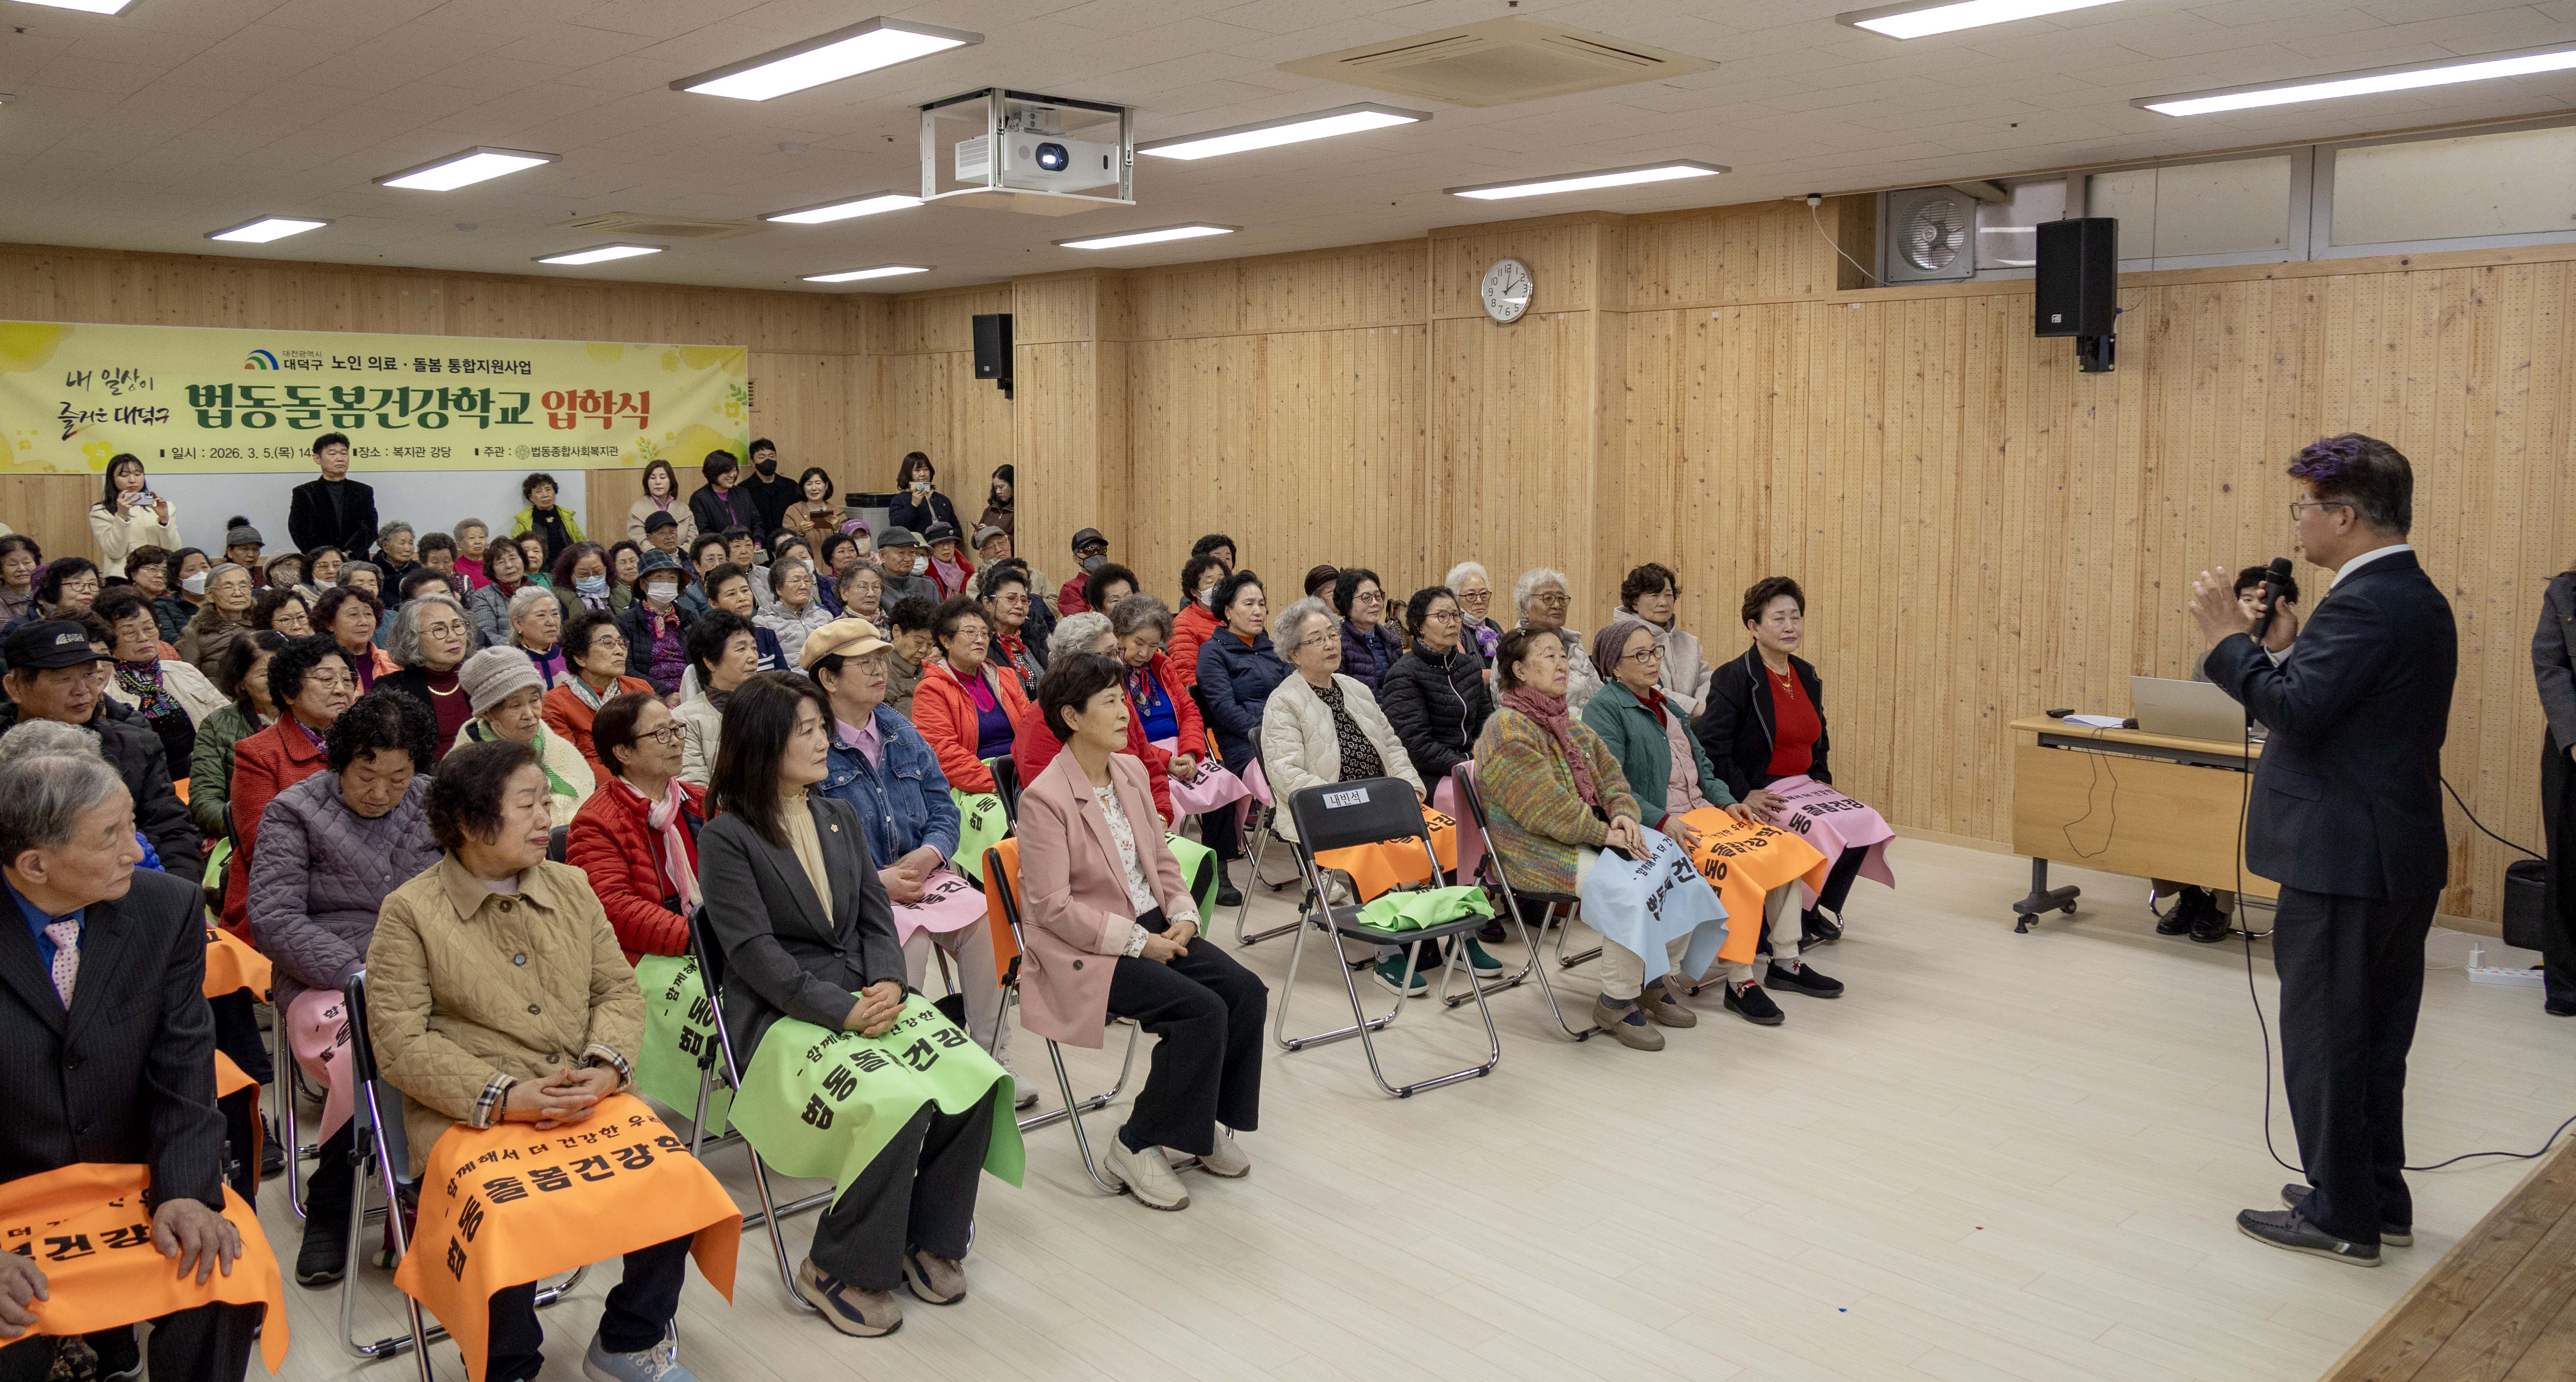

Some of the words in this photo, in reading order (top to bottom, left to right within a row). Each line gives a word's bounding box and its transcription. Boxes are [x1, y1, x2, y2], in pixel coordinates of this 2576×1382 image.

[1498, 268, 1502, 277] 11
[1505, 264, 1512, 273] 12
[1491, 277, 1498, 285] 10
[1520, 273, 1525, 282] 2
[1488, 288, 1493, 296] 9
[1523, 284, 1528, 293] 3
[1491, 299, 1496, 307] 8
[1514, 303, 1519, 312] 5
[1498, 305, 1503, 314] 7
[1505, 307, 1510, 316] 6
[283, 350, 322, 358] 대전광역시
[284, 358, 323, 371] 대덕구
[331, 356, 362, 370] 노인
[368, 356, 398, 371] 의료
[413, 358, 442, 373] 돌봄
[447, 358, 532, 375] 통합지원사업
[66, 370, 92, 392] 내
[101, 367, 154, 396] 일상이
[185, 382, 534, 430] 법동돌봄건강학교
[541, 389, 650, 430] 입학식
[58, 401, 109, 441] 즐거운
[114, 406, 170, 426] 대덕구
[172, 448, 196, 459] 일시
[210, 448, 243, 459] 2026.
[248, 448, 258, 459] 3.
[264, 447, 295, 459] 5.(목)
[358, 446, 381, 458] 장소
[393, 446, 426, 458] 복지관
[431, 446, 451, 458] 강당
[484, 446, 504, 458] 주관
[532, 446, 619, 457] 법동종합사회복지관
[1330, 791, 1361, 806] 내빈석
[1656, 843, 1667, 853] 더
[447, 1149, 519, 1198] 함께해서
[529, 1144, 549, 1155] 더
[556, 1125, 620, 1149] 건강한
